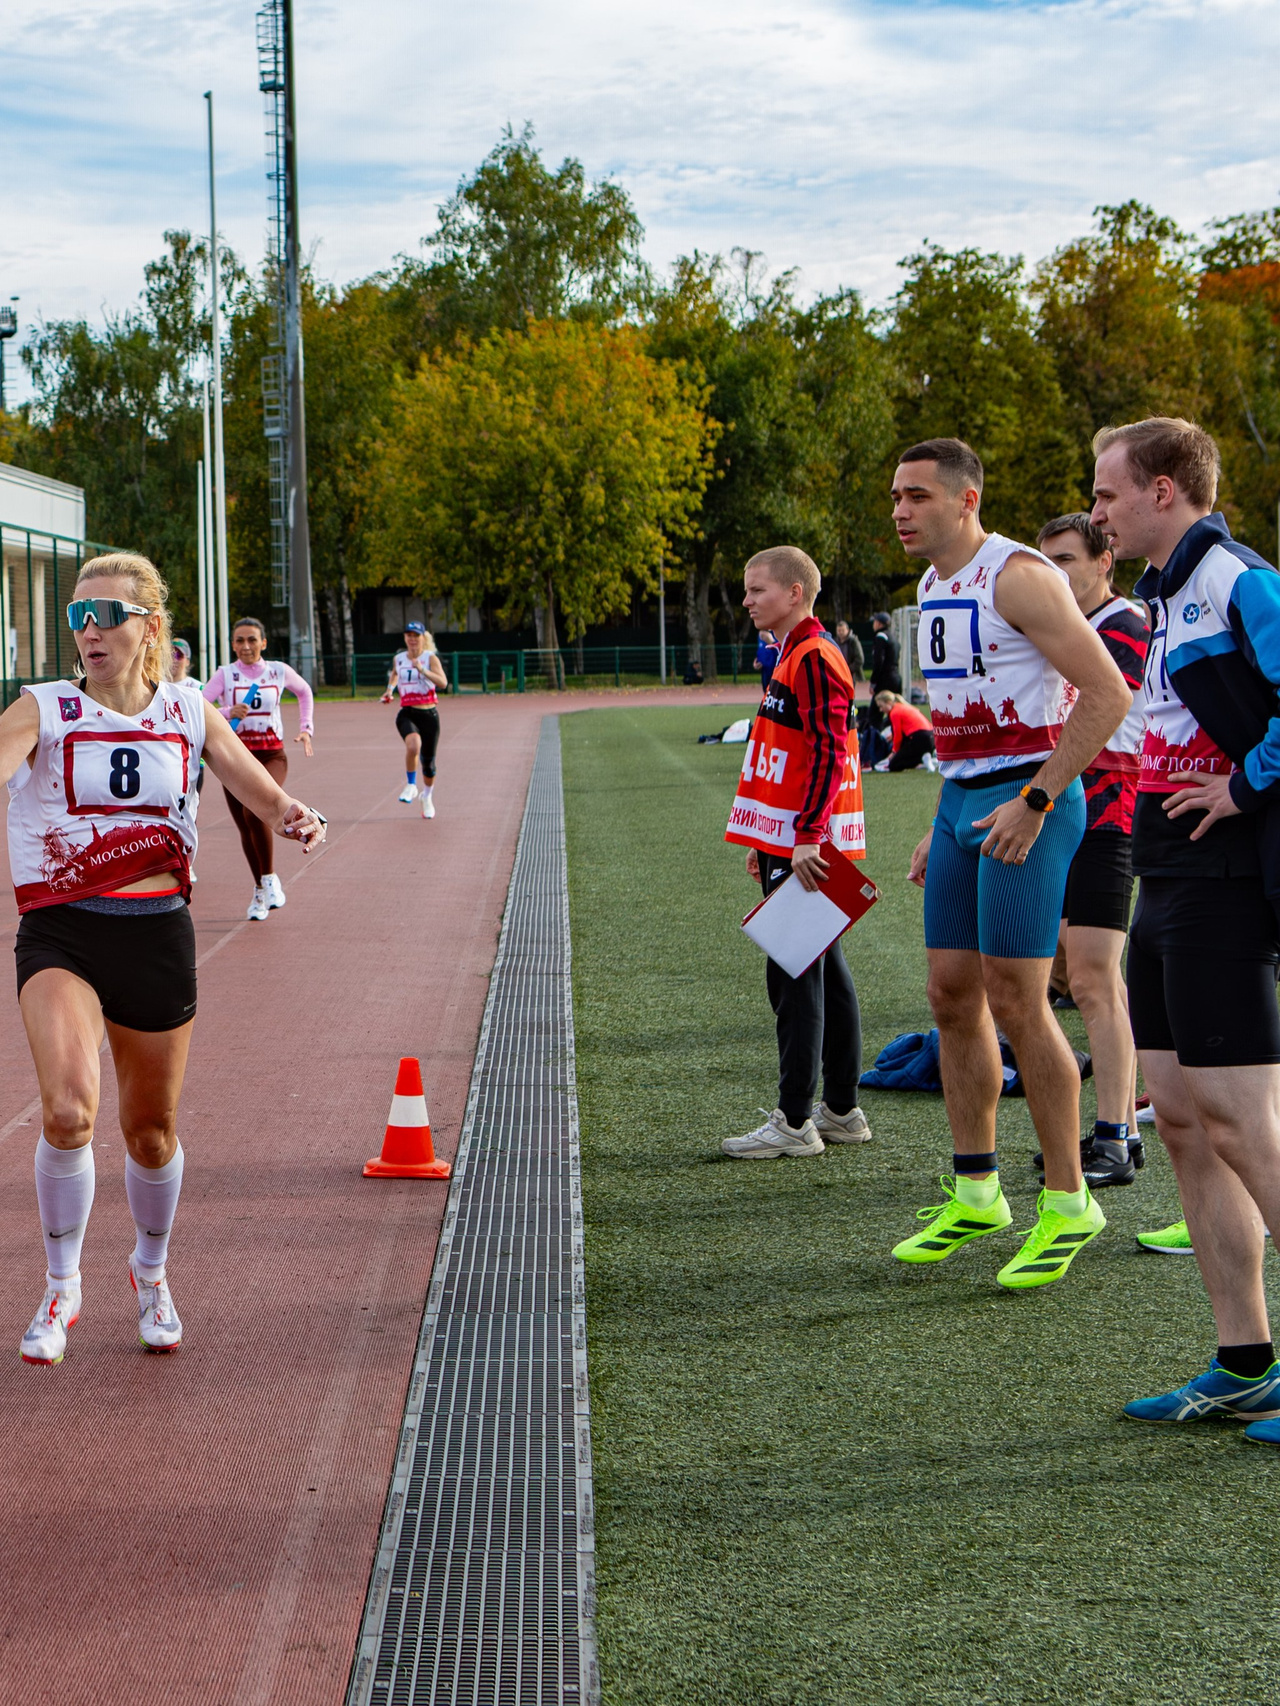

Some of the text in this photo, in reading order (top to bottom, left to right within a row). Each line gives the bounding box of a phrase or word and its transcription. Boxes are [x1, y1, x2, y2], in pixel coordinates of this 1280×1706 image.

[930, 616, 946, 664] 8
[972, 655, 986, 677] 4
[250, 691, 262, 710] 6
[109, 747, 141, 799] 8
[742, 739, 788, 784] ДЬЯ
[758, 813, 785, 837] СПОРТ
